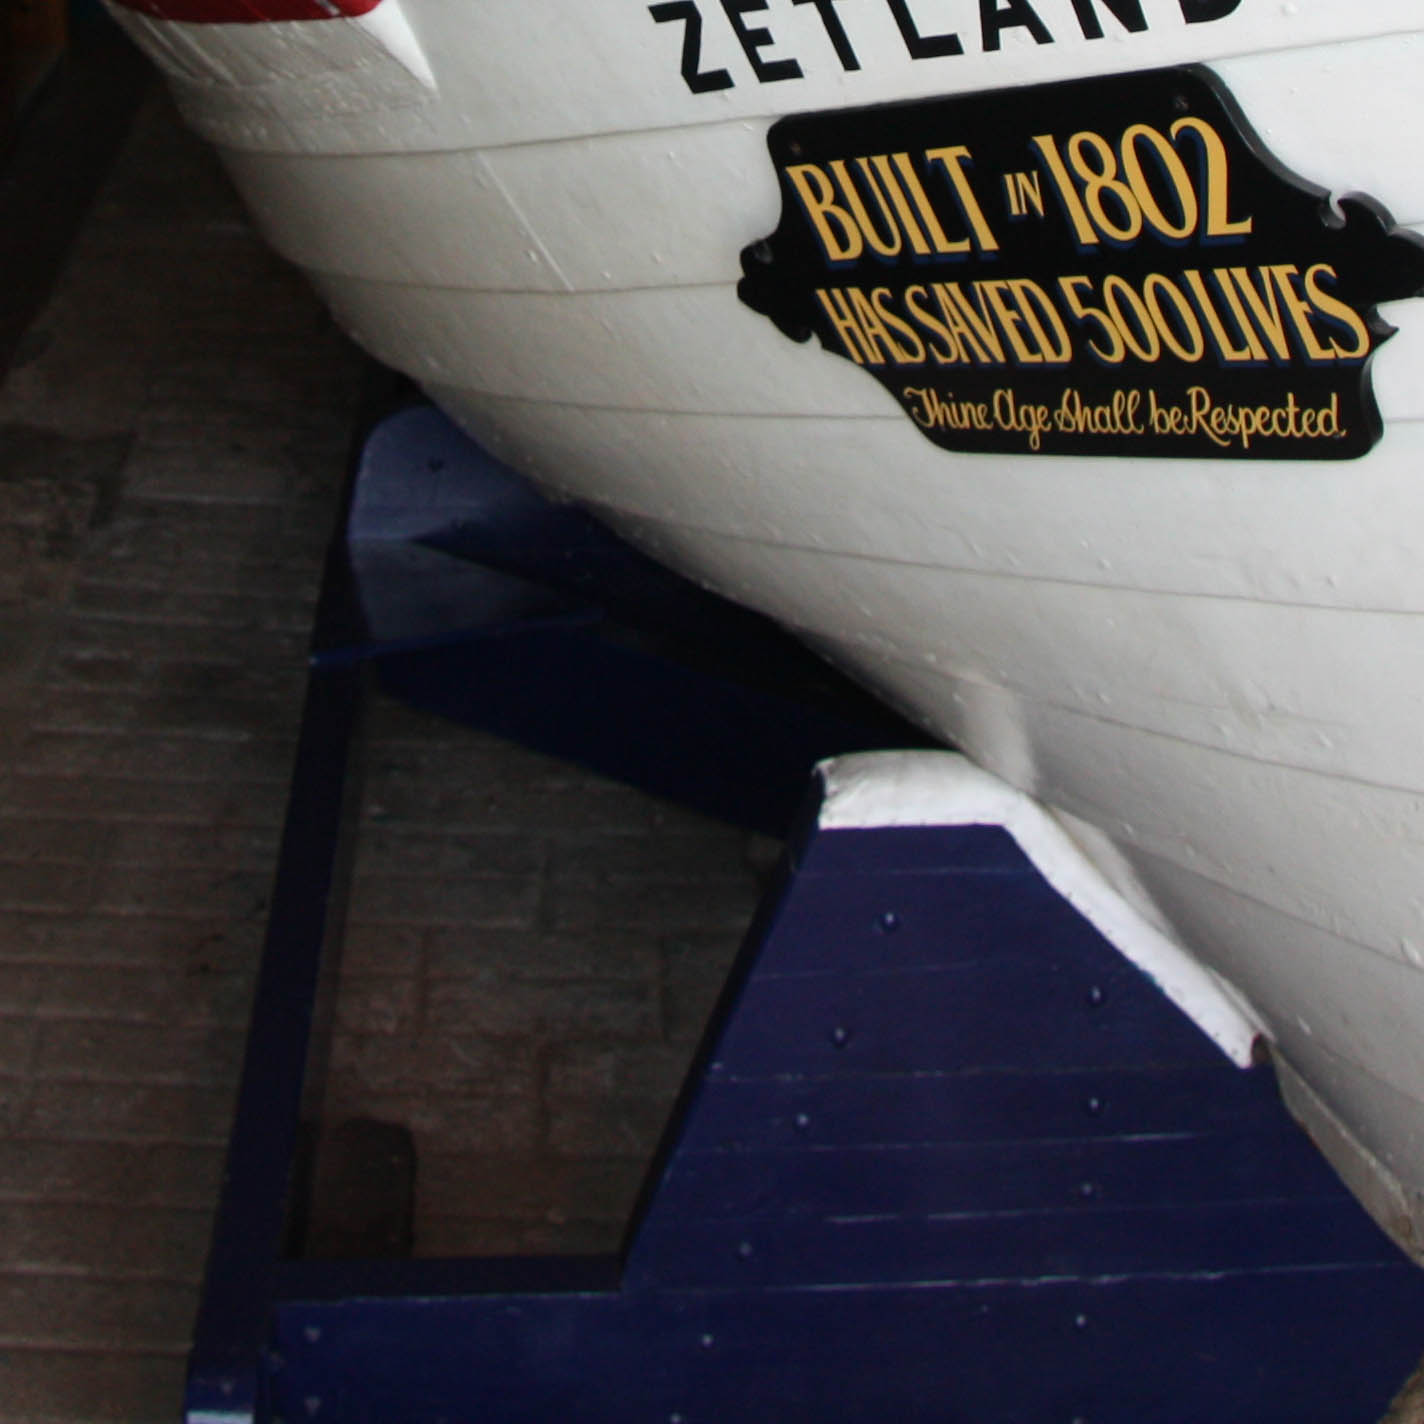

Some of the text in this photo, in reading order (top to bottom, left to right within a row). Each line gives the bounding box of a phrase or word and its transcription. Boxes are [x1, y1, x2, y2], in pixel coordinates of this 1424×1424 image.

[785, 116, 1253, 263] BUILT IN 1802
[815, 262, 1371, 366] HAS SAVED 500 LIVES
[902, 386, 994, 430] Thine
[1148, 388, 1188, 435] be
